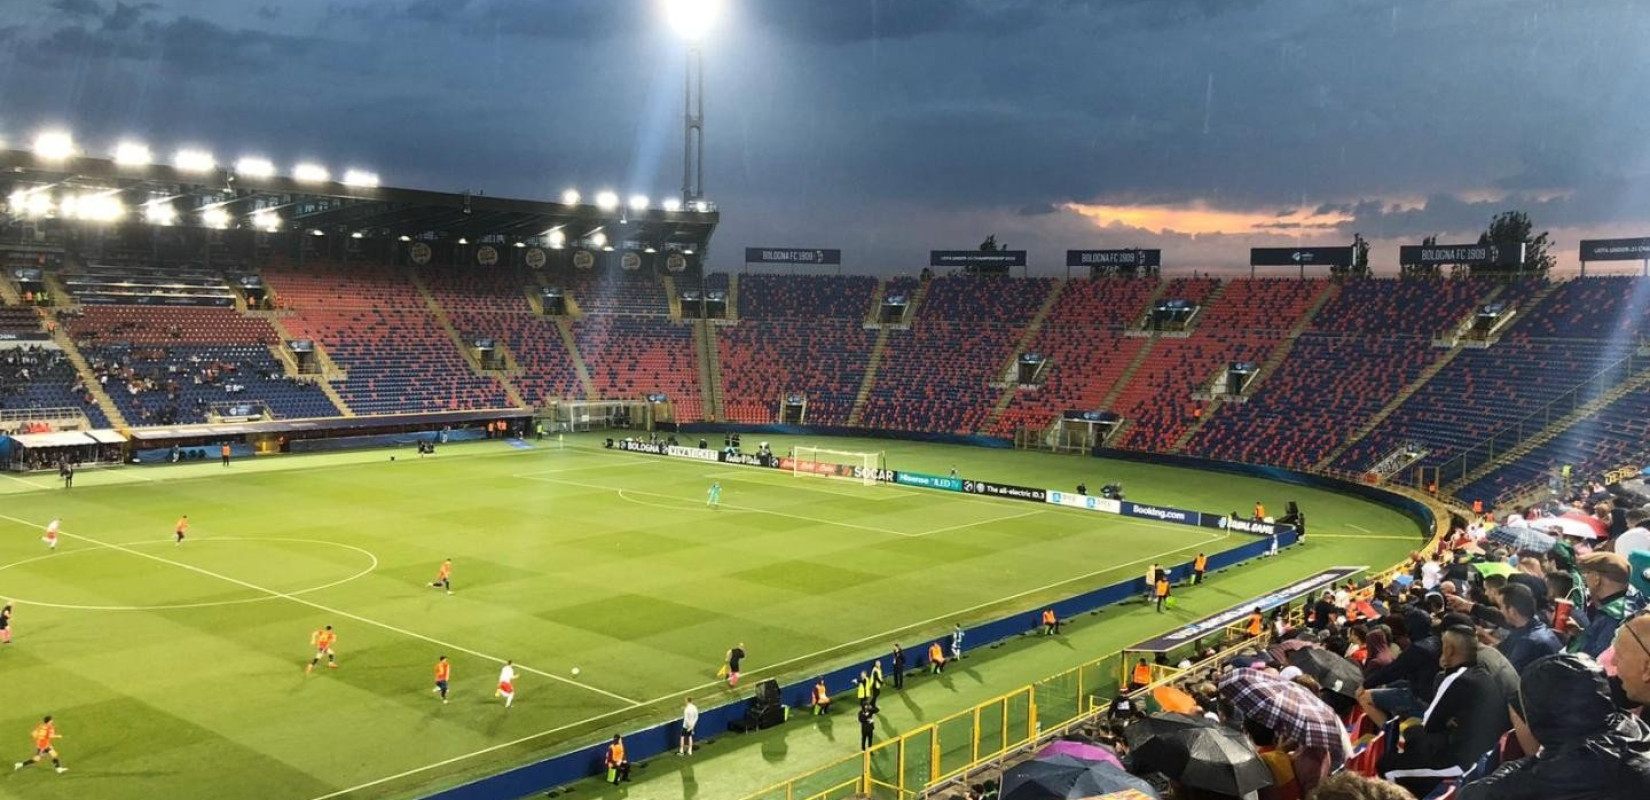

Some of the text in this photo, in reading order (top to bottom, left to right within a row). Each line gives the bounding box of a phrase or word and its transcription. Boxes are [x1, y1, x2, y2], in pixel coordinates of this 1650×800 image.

[762, 250, 789, 260] BOLOGNA
[790, 251, 798, 260] FC
[1081, 252, 1135, 263] BOLOGNA FC 1909
[1421, 248, 1486, 261] BOLOGNA FC 1909
[627, 441, 660, 454] BOLOGNA
[854, 465, 894, 482] SOCAR
[899, 473, 929, 485] Hisense
[987, 485, 998, 494] The
[999, 486, 1031, 498] all-electric
[1133, 504, 1185, 520] Booking.com
